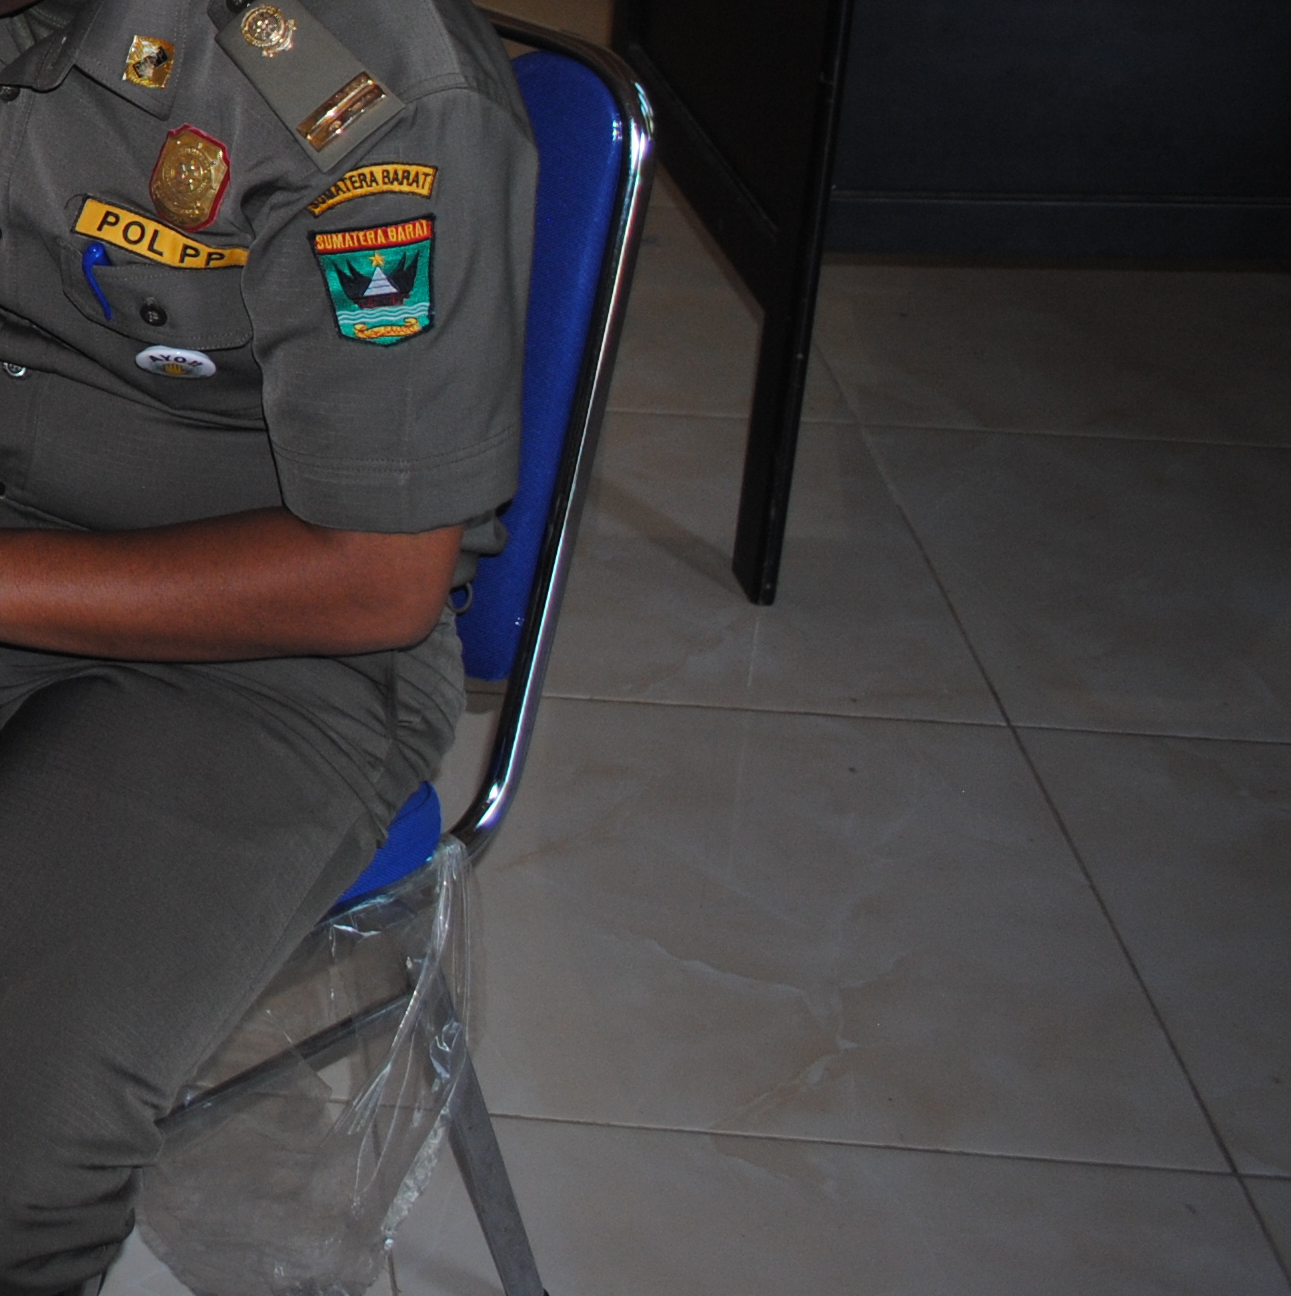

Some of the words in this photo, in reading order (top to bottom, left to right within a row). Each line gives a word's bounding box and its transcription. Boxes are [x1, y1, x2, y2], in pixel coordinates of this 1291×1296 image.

[310, 171, 380, 209] SUMATERA
[381, 168, 433, 191] BARAT
[96, 210, 164, 257] POL
[178, 243, 226, 267] PP
[315, 229, 386, 250] SUMATERA
[388, 219, 429, 242] BARAT
